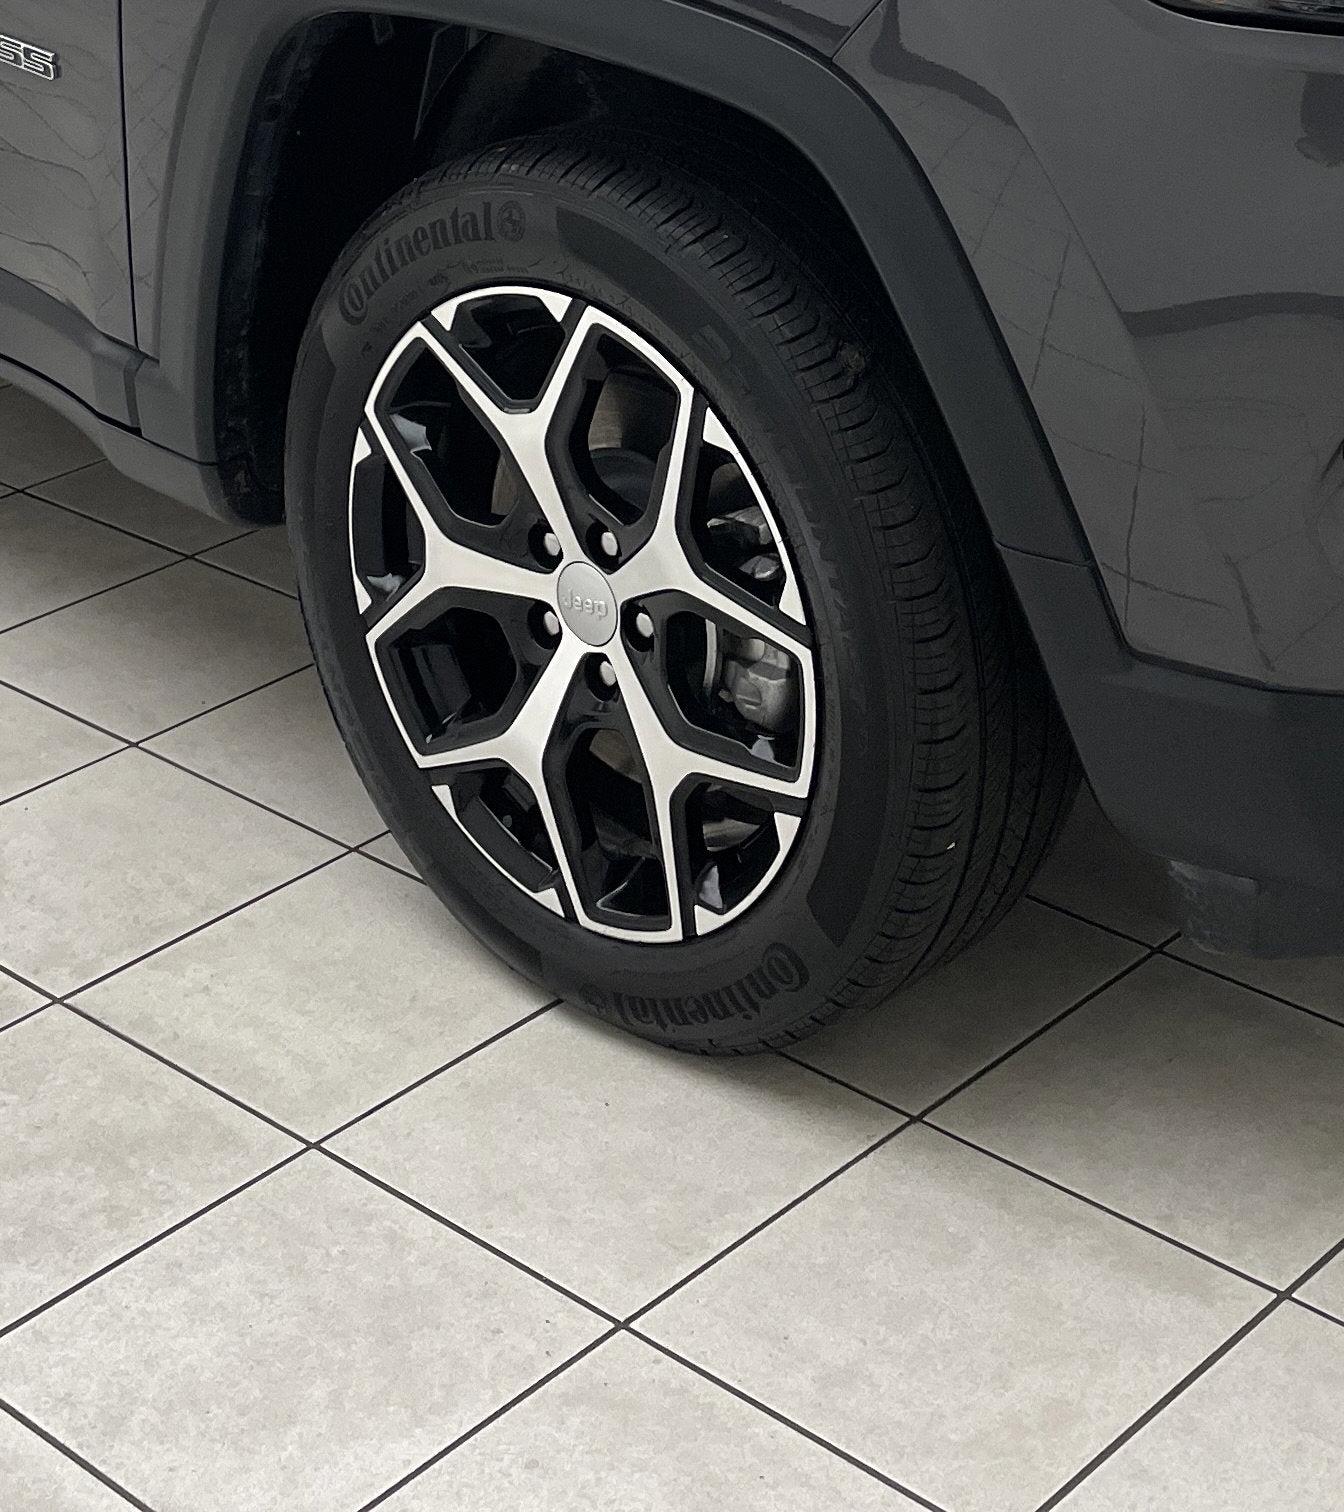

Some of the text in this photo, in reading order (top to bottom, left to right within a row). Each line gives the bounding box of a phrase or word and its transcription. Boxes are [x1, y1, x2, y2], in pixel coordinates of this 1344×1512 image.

[338, 201, 496, 325] Continental
[561, 589, 608, 620] Jeep
[611, 942, 810, 1031] Continental
